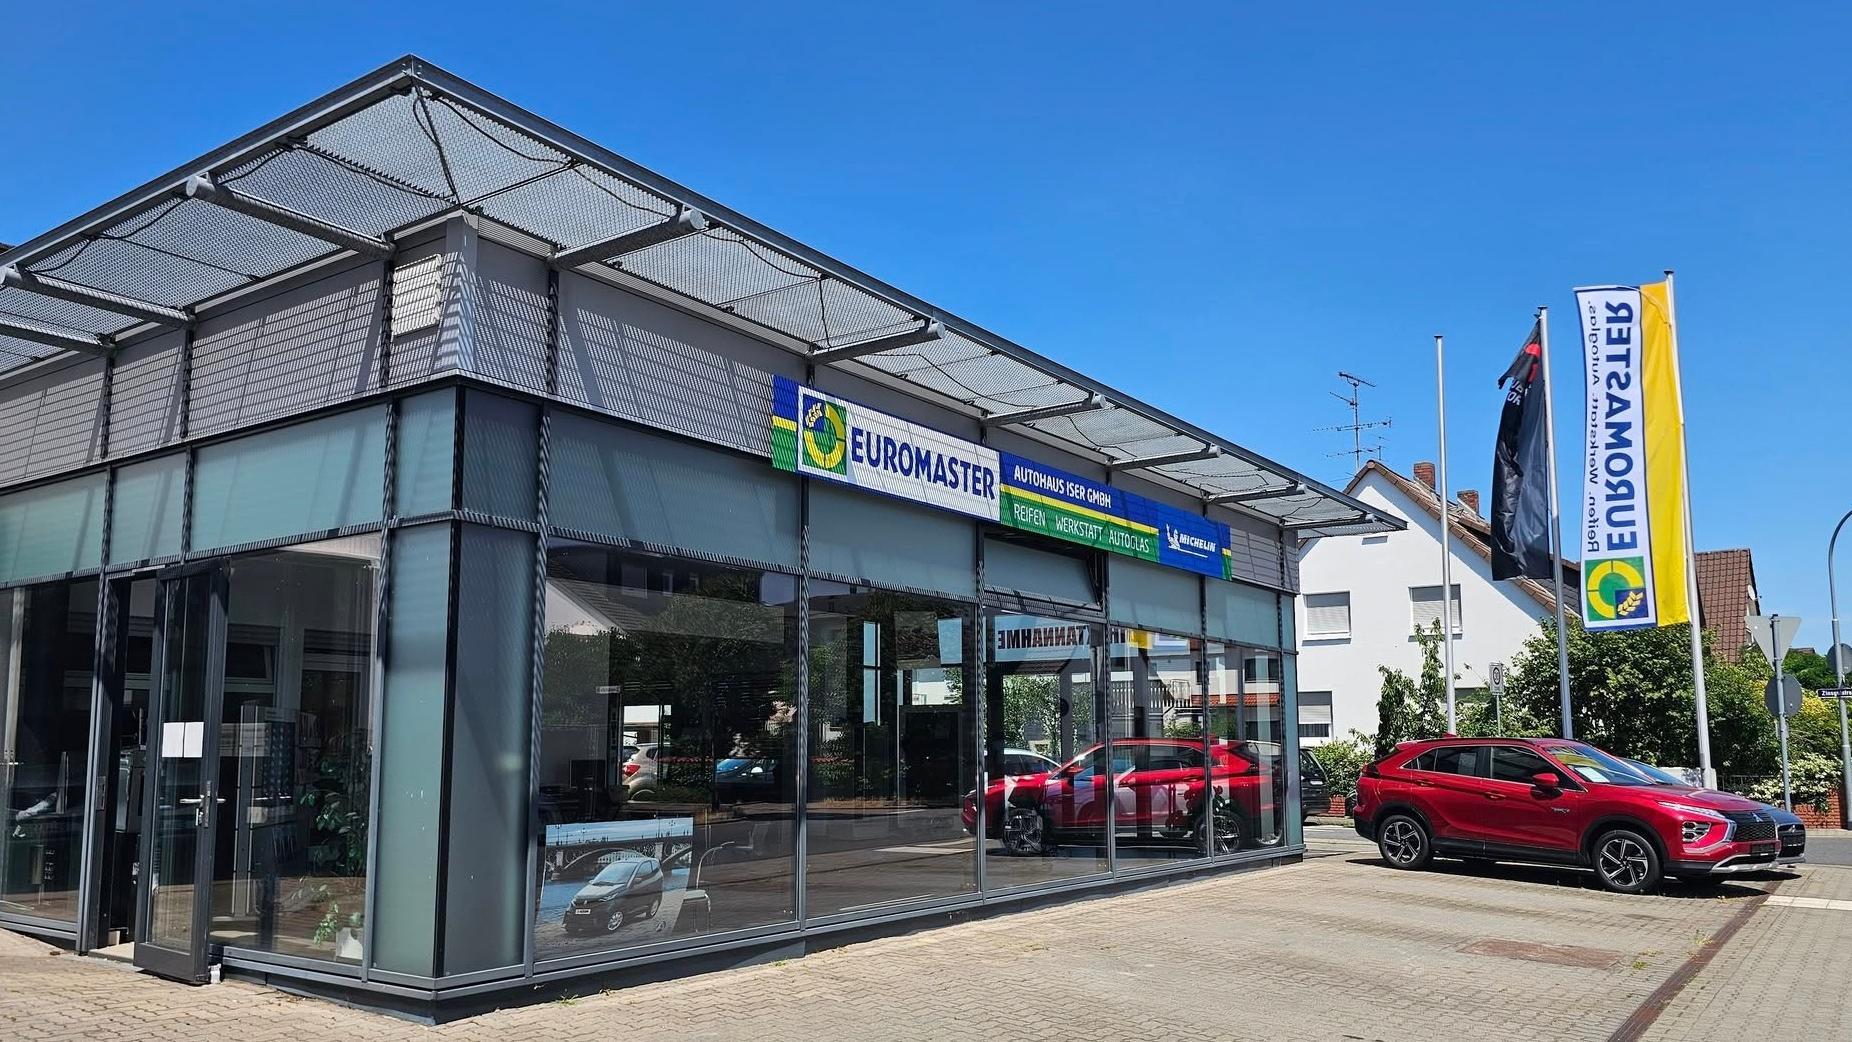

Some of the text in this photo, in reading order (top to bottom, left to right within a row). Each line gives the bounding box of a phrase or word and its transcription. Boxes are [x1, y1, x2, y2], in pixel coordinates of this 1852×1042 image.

[851, 426, 996, 500] EUROMASTER
[1014, 464, 1112, 509] AUTOHAUS ISER GMBH
[1013, 503, 1150, 554] REIFEN WERKSTATT AUTOGLAS
[1179, 533, 1217, 553] MICHELIN
